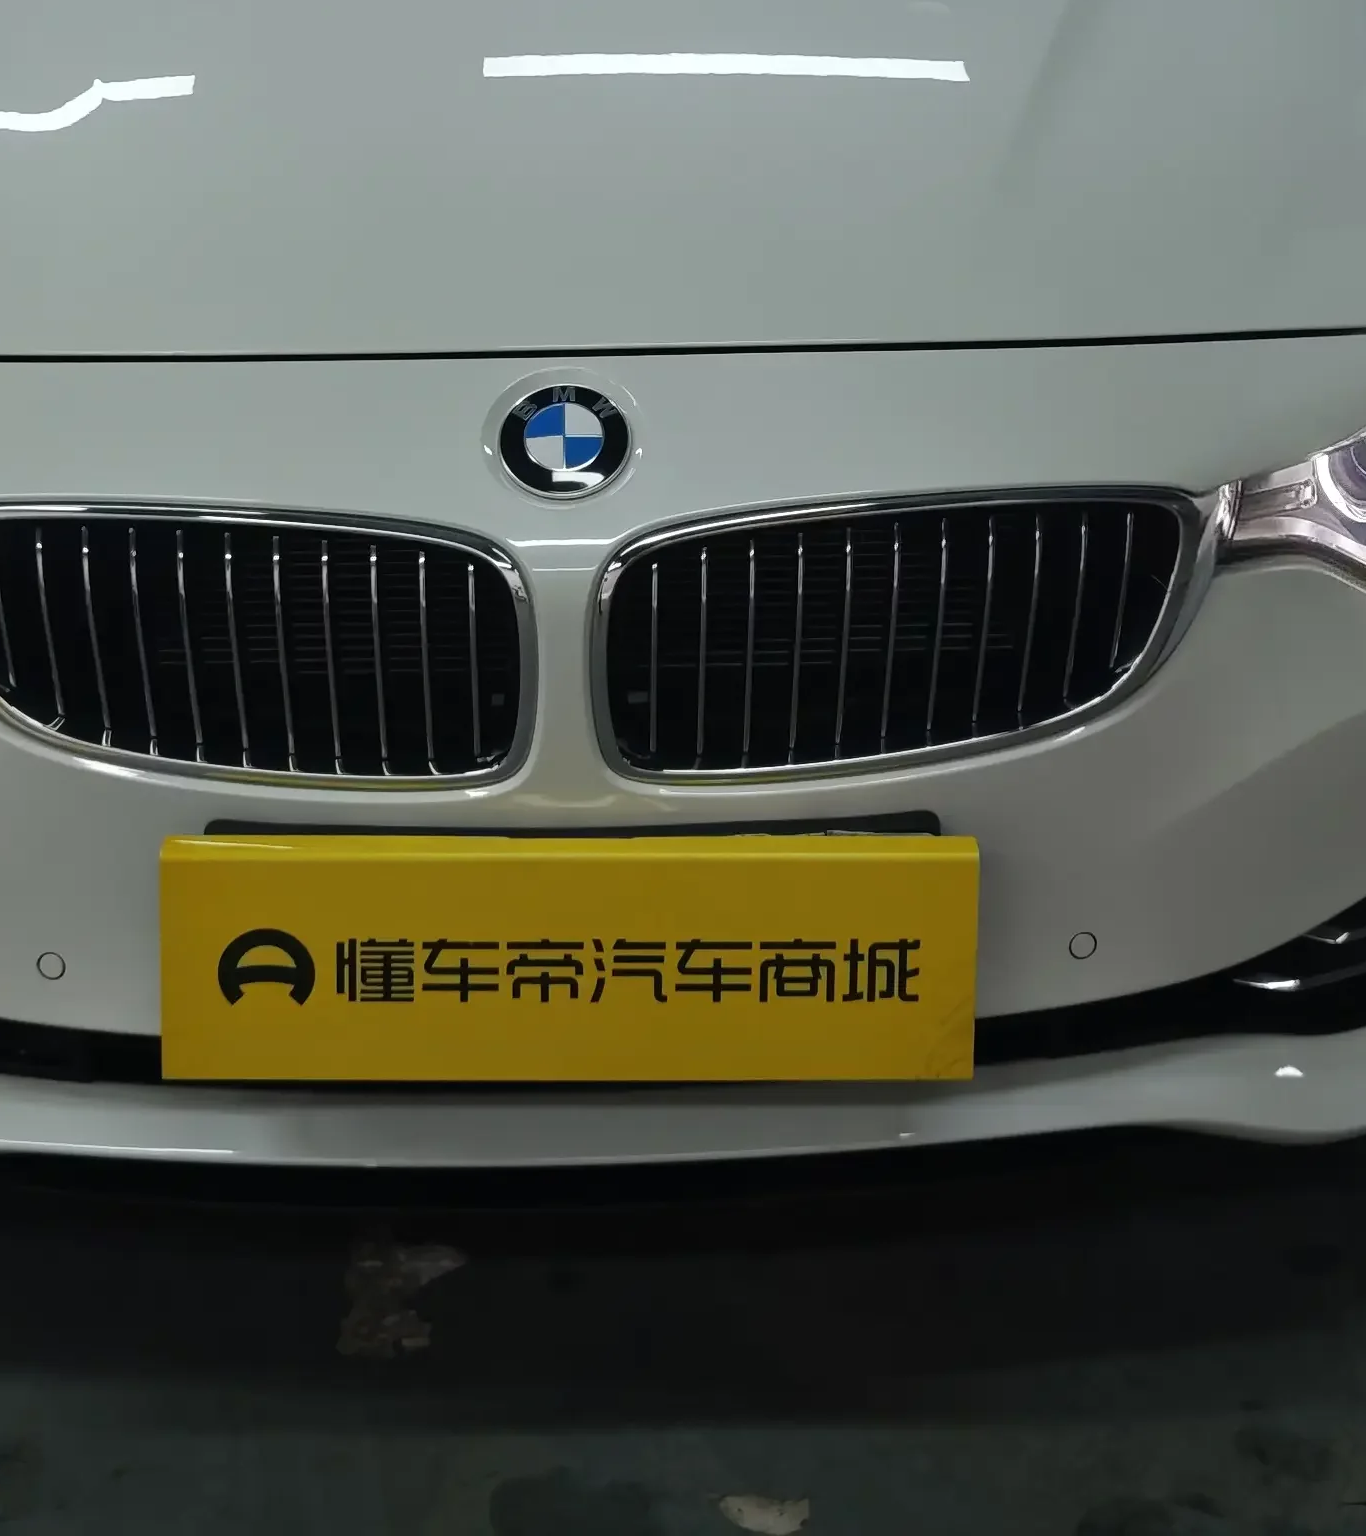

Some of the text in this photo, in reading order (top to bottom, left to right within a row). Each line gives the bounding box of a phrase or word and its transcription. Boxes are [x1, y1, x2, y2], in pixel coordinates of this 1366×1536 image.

[512, 386, 618, 421] BMW
[335, 938, 921, 1004] 懂车帝汽车商城
